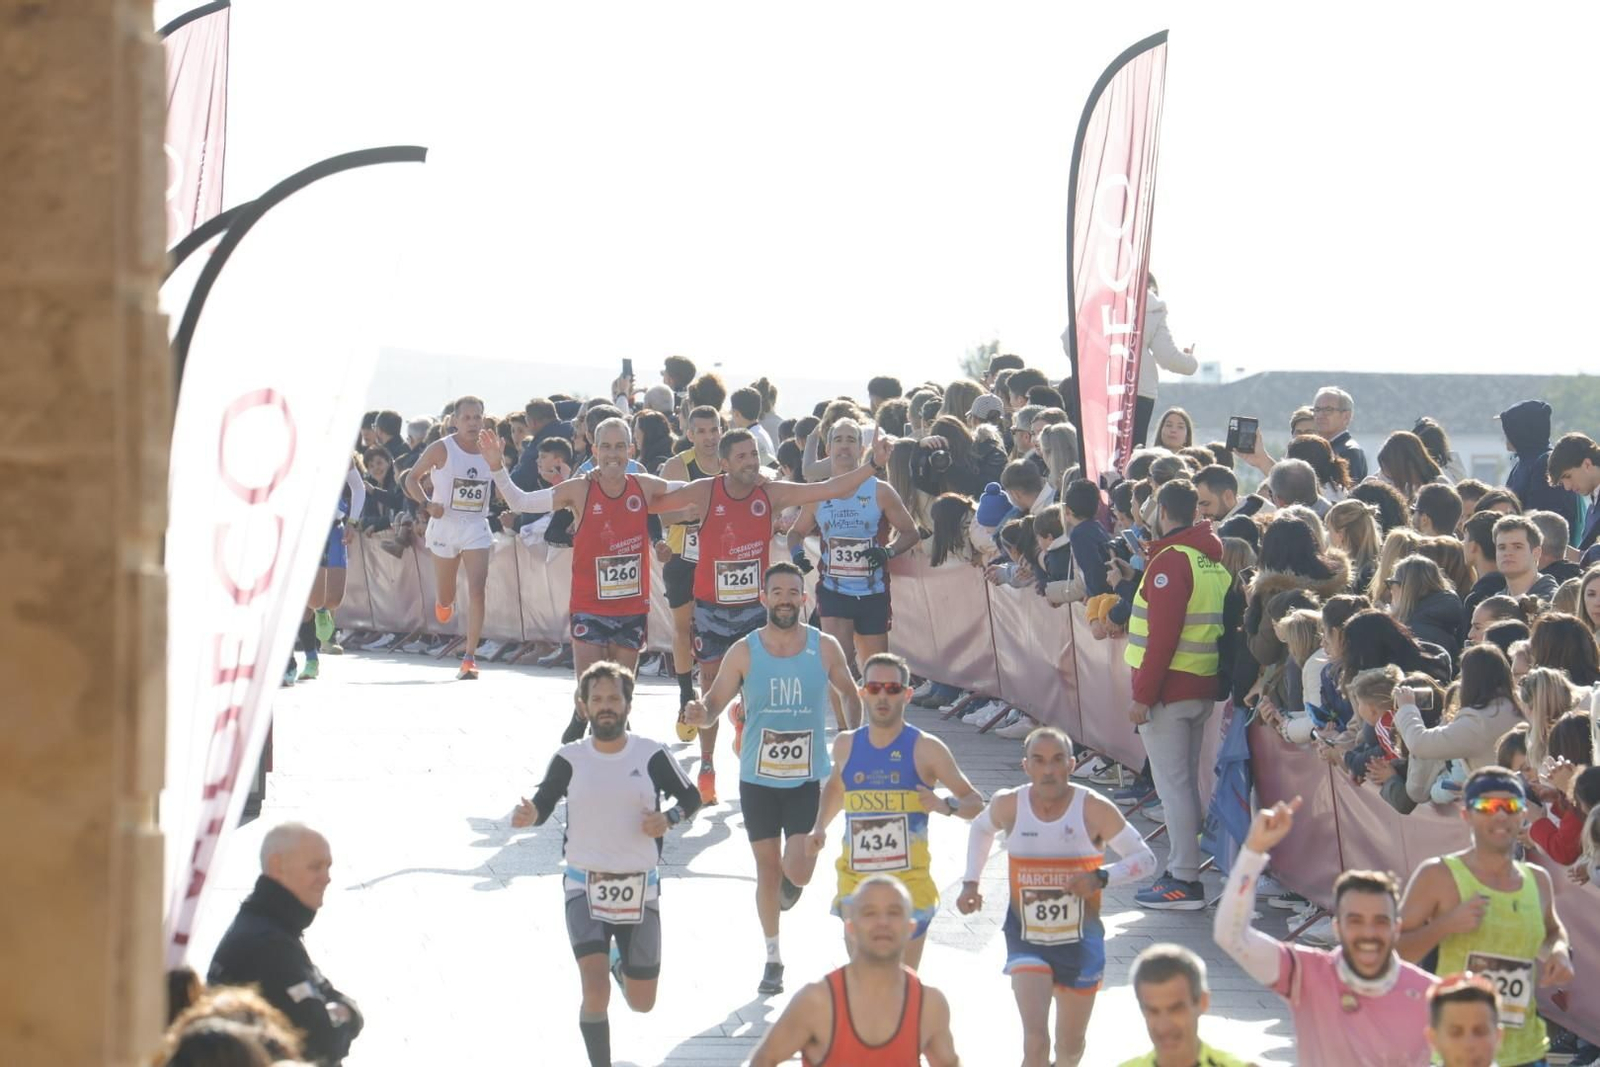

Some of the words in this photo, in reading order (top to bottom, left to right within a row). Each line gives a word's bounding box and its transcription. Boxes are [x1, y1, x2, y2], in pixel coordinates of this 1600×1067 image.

[459, 488, 482, 500] 968
[836, 550, 861, 562] 339
[603, 566, 637, 582] 1260
[723, 572, 754, 586] 1261
[769, 677, 802, 707] ENA
[768, 745, 803, 760] 690
[850, 791, 912, 811] OSSET
[860, 833, 897, 850] 434
[597, 886, 634, 902] 390
[1036, 904, 1068, 921] 891
[1483, 973, 1523, 998] 20
